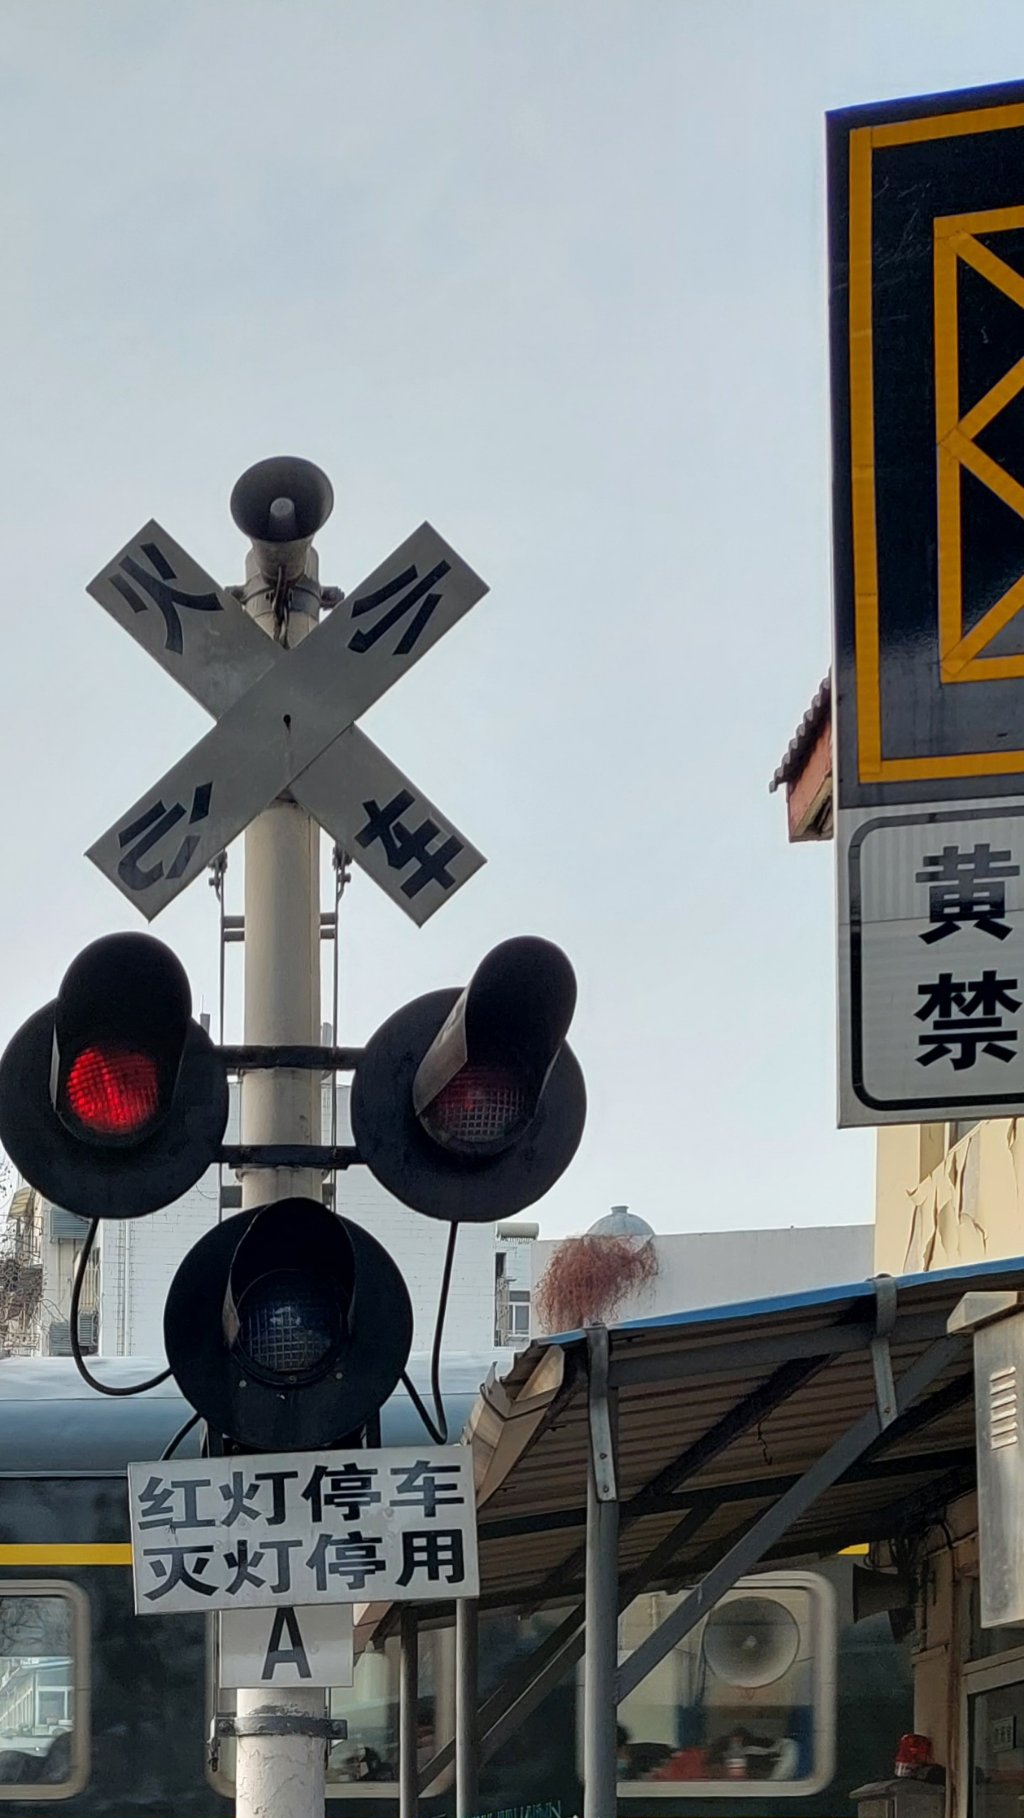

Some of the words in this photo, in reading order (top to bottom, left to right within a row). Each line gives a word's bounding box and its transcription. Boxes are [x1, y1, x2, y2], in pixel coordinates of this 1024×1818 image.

[915, 843, 1020, 944] 黄
[914, 970, 1023, 1071] 禁
[138, 1460, 464, 1531] 红灯停车
[143, 1529, 466, 1601] 灭灯停用
[261, 1608, 312, 1680] A
